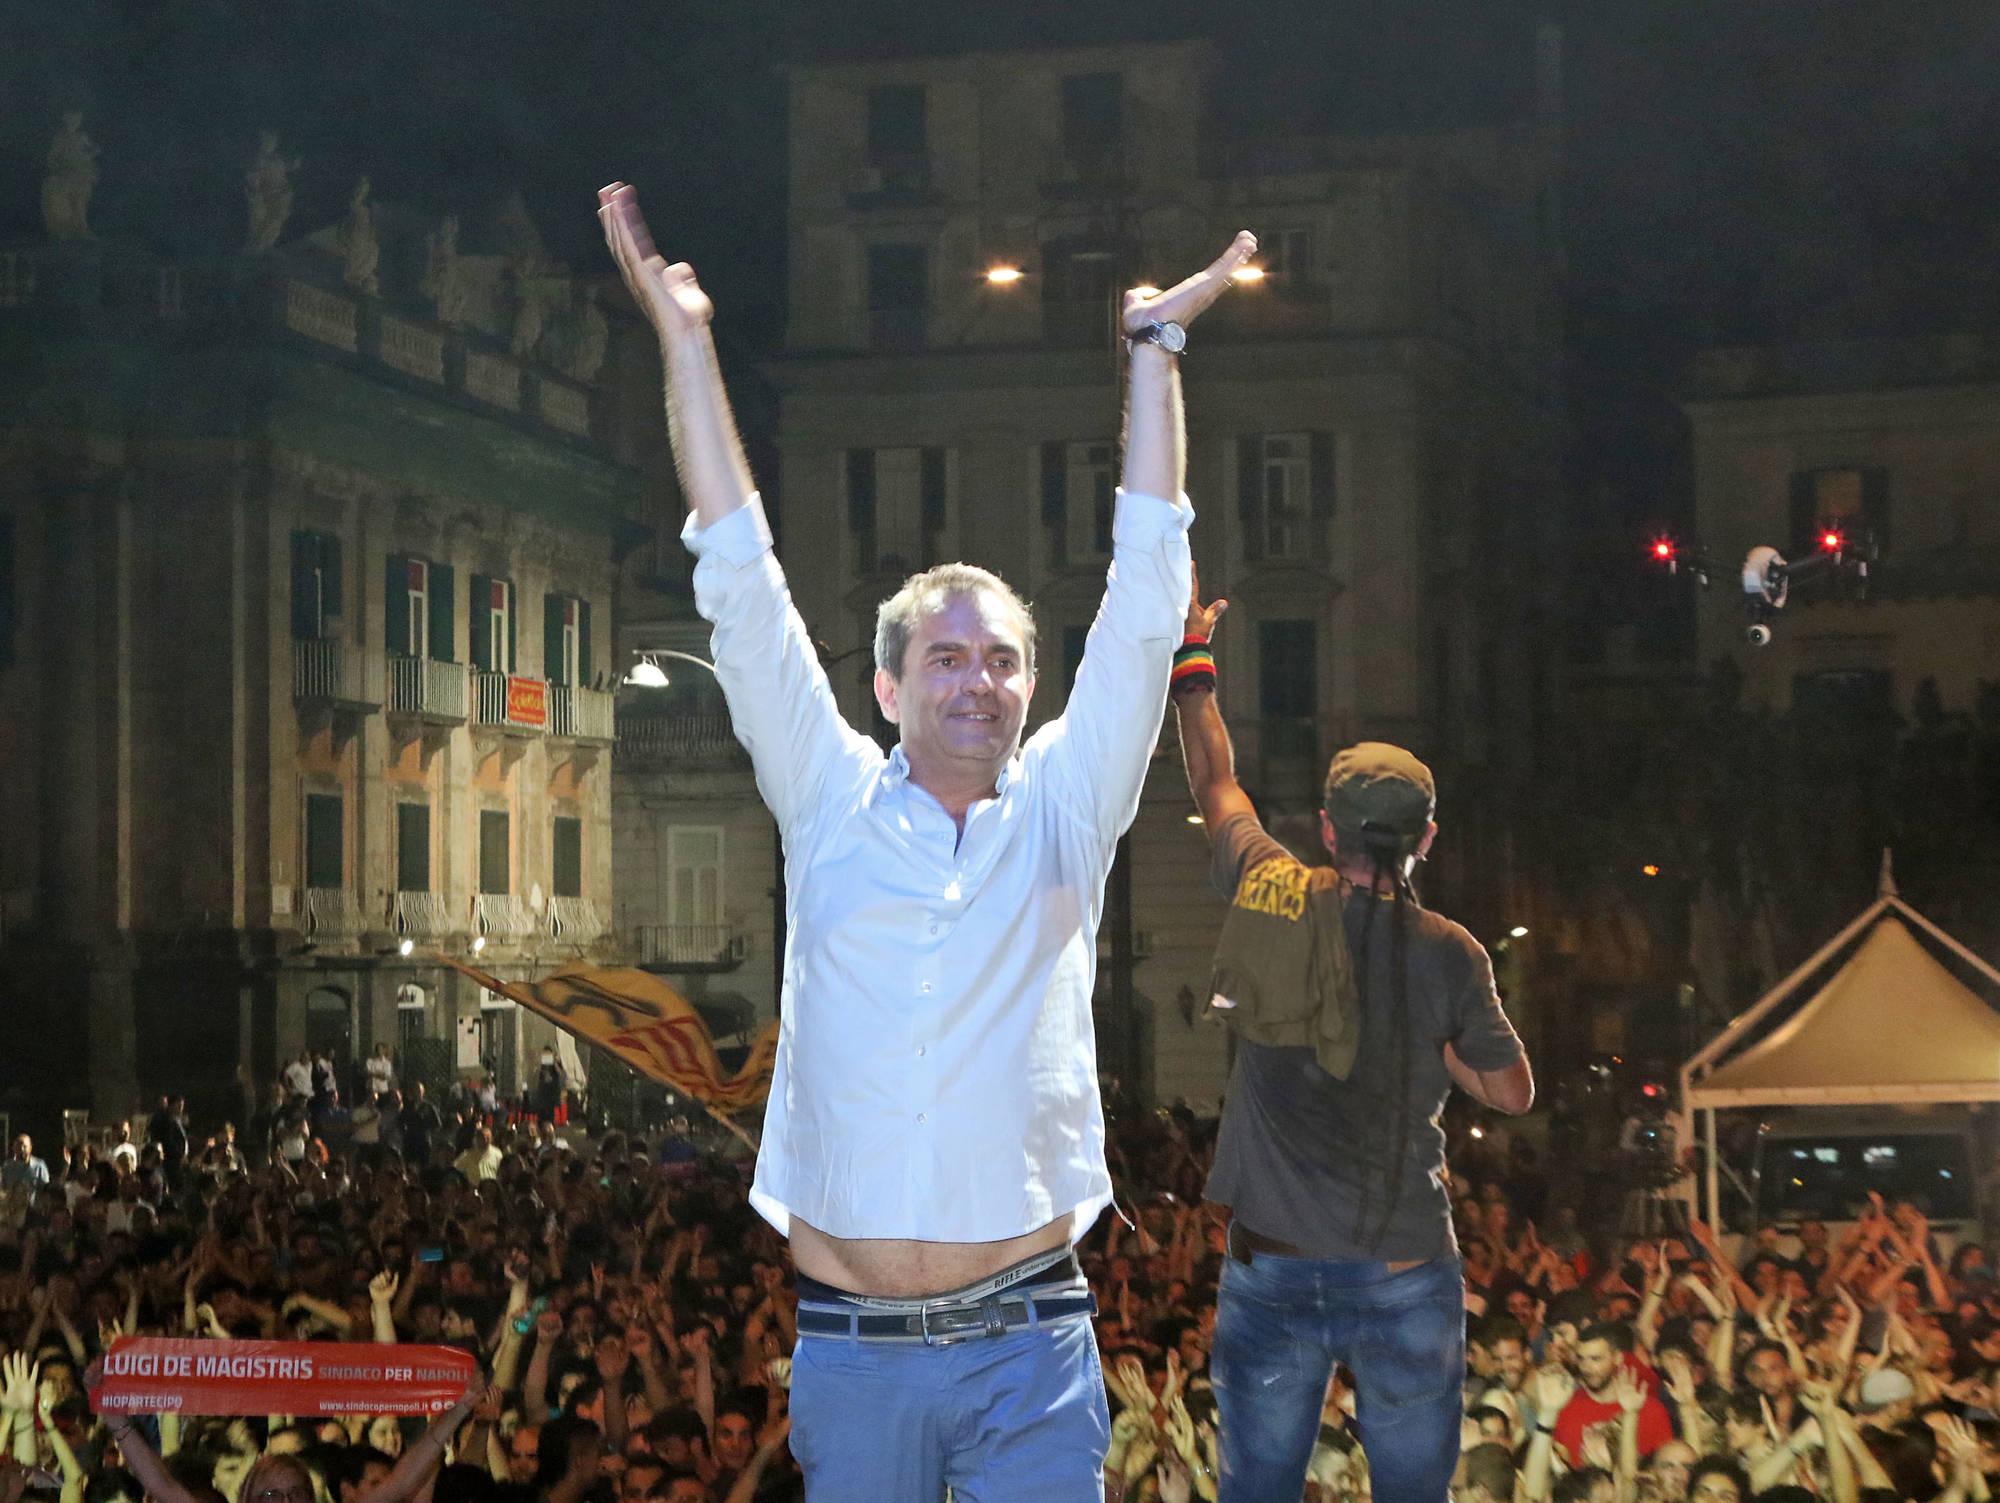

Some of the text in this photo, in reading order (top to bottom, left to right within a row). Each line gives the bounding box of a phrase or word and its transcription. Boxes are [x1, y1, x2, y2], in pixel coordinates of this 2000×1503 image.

[994, 1269, 1022, 1288] RIFLE
[103, 1354, 158, 1376] LUIGI
[163, 1356, 192, 1376] DE
[196, 1356, 313, 1379] MAGISTRIS
[318, 1366, 381, 1380] SINDACO
[384, 1367, 413, 1381] PER
[102, 1393, 183, 1408] #IOPARTECIPO
[319, 1401, 428, 1412] www.sindacopernapoli.it
